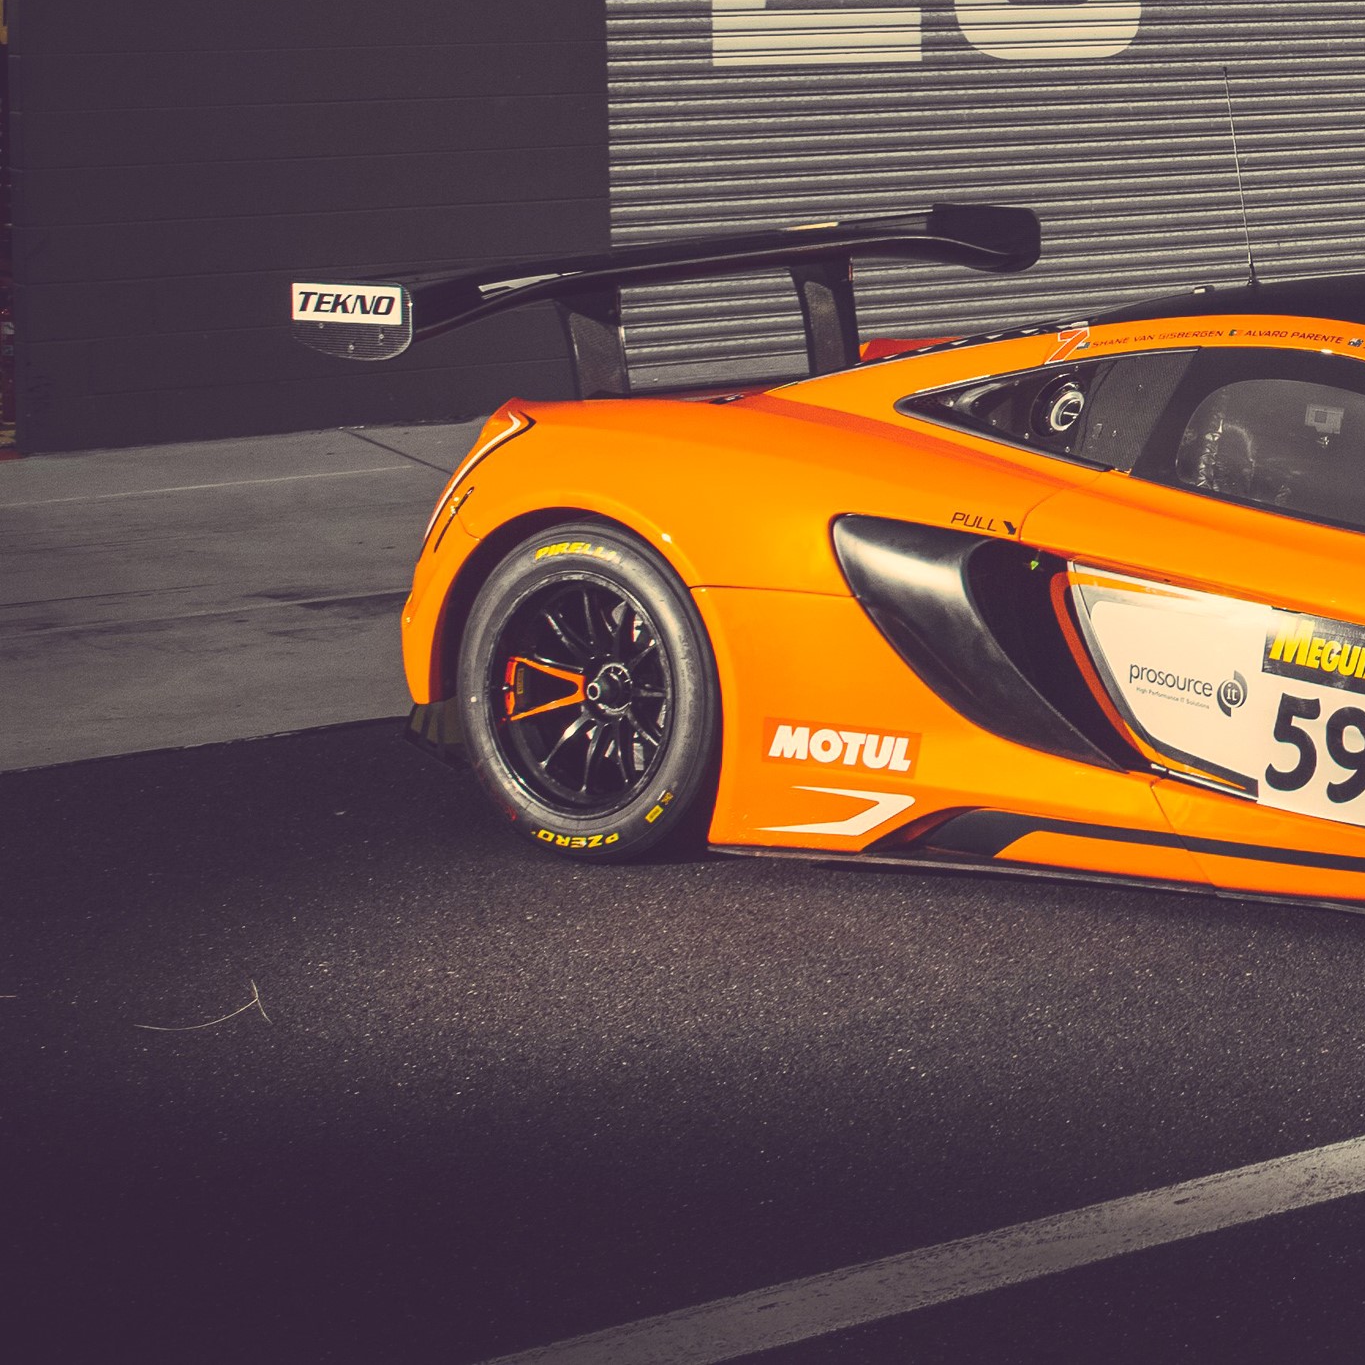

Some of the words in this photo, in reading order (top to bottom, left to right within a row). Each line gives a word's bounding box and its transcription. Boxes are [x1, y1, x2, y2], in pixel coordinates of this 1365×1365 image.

[299, 291, 396, 315] TEKNO
[1092, 337, 1130, 347] SHANE
[1158, 330, 1224, 340] GISBERGEN
[1244, 330, 1288, 338] ALVARO
[1291, 331, 1344, 344] PARENTE
[950, 511, 997, 532] PULL
[535, 541, 623, 565] PIRELLI
[1129, 664, 1213, 697] prosource
[769, 724, 911, 772] MOTUL
